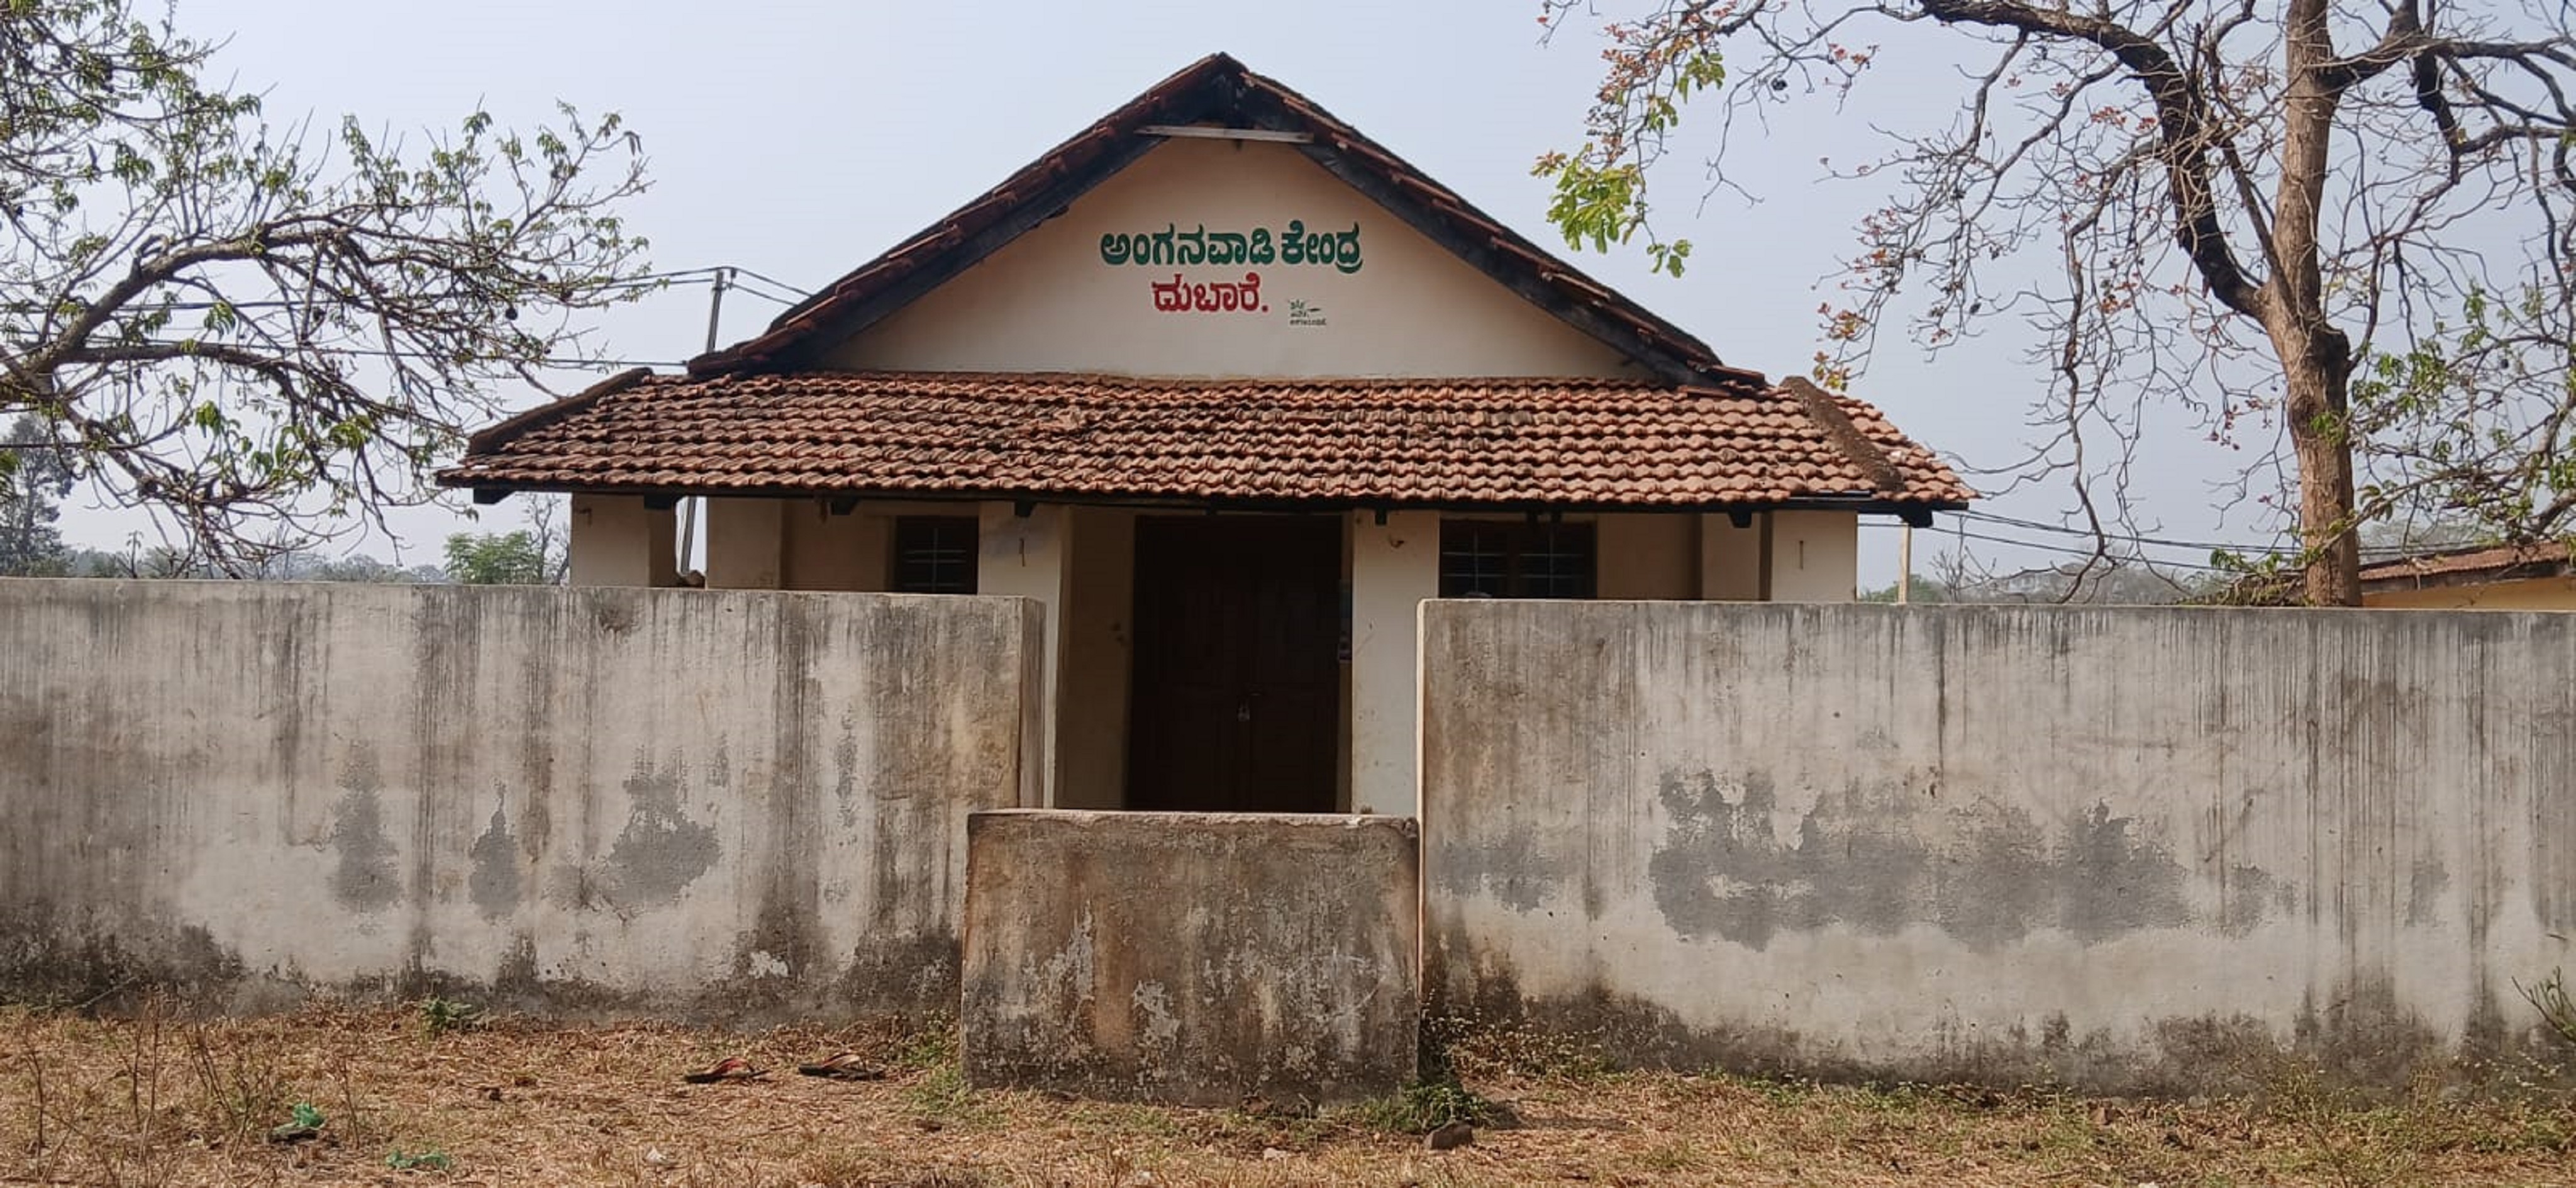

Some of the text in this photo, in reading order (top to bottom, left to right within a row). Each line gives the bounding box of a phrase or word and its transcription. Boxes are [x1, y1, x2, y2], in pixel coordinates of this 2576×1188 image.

[1101, 220, 1363, 274] ಅಂಗನವಾಡಿ ಕೇಂದ್ರ
[1152, 272, 1269, 313] ದುಬಾರೆ.
